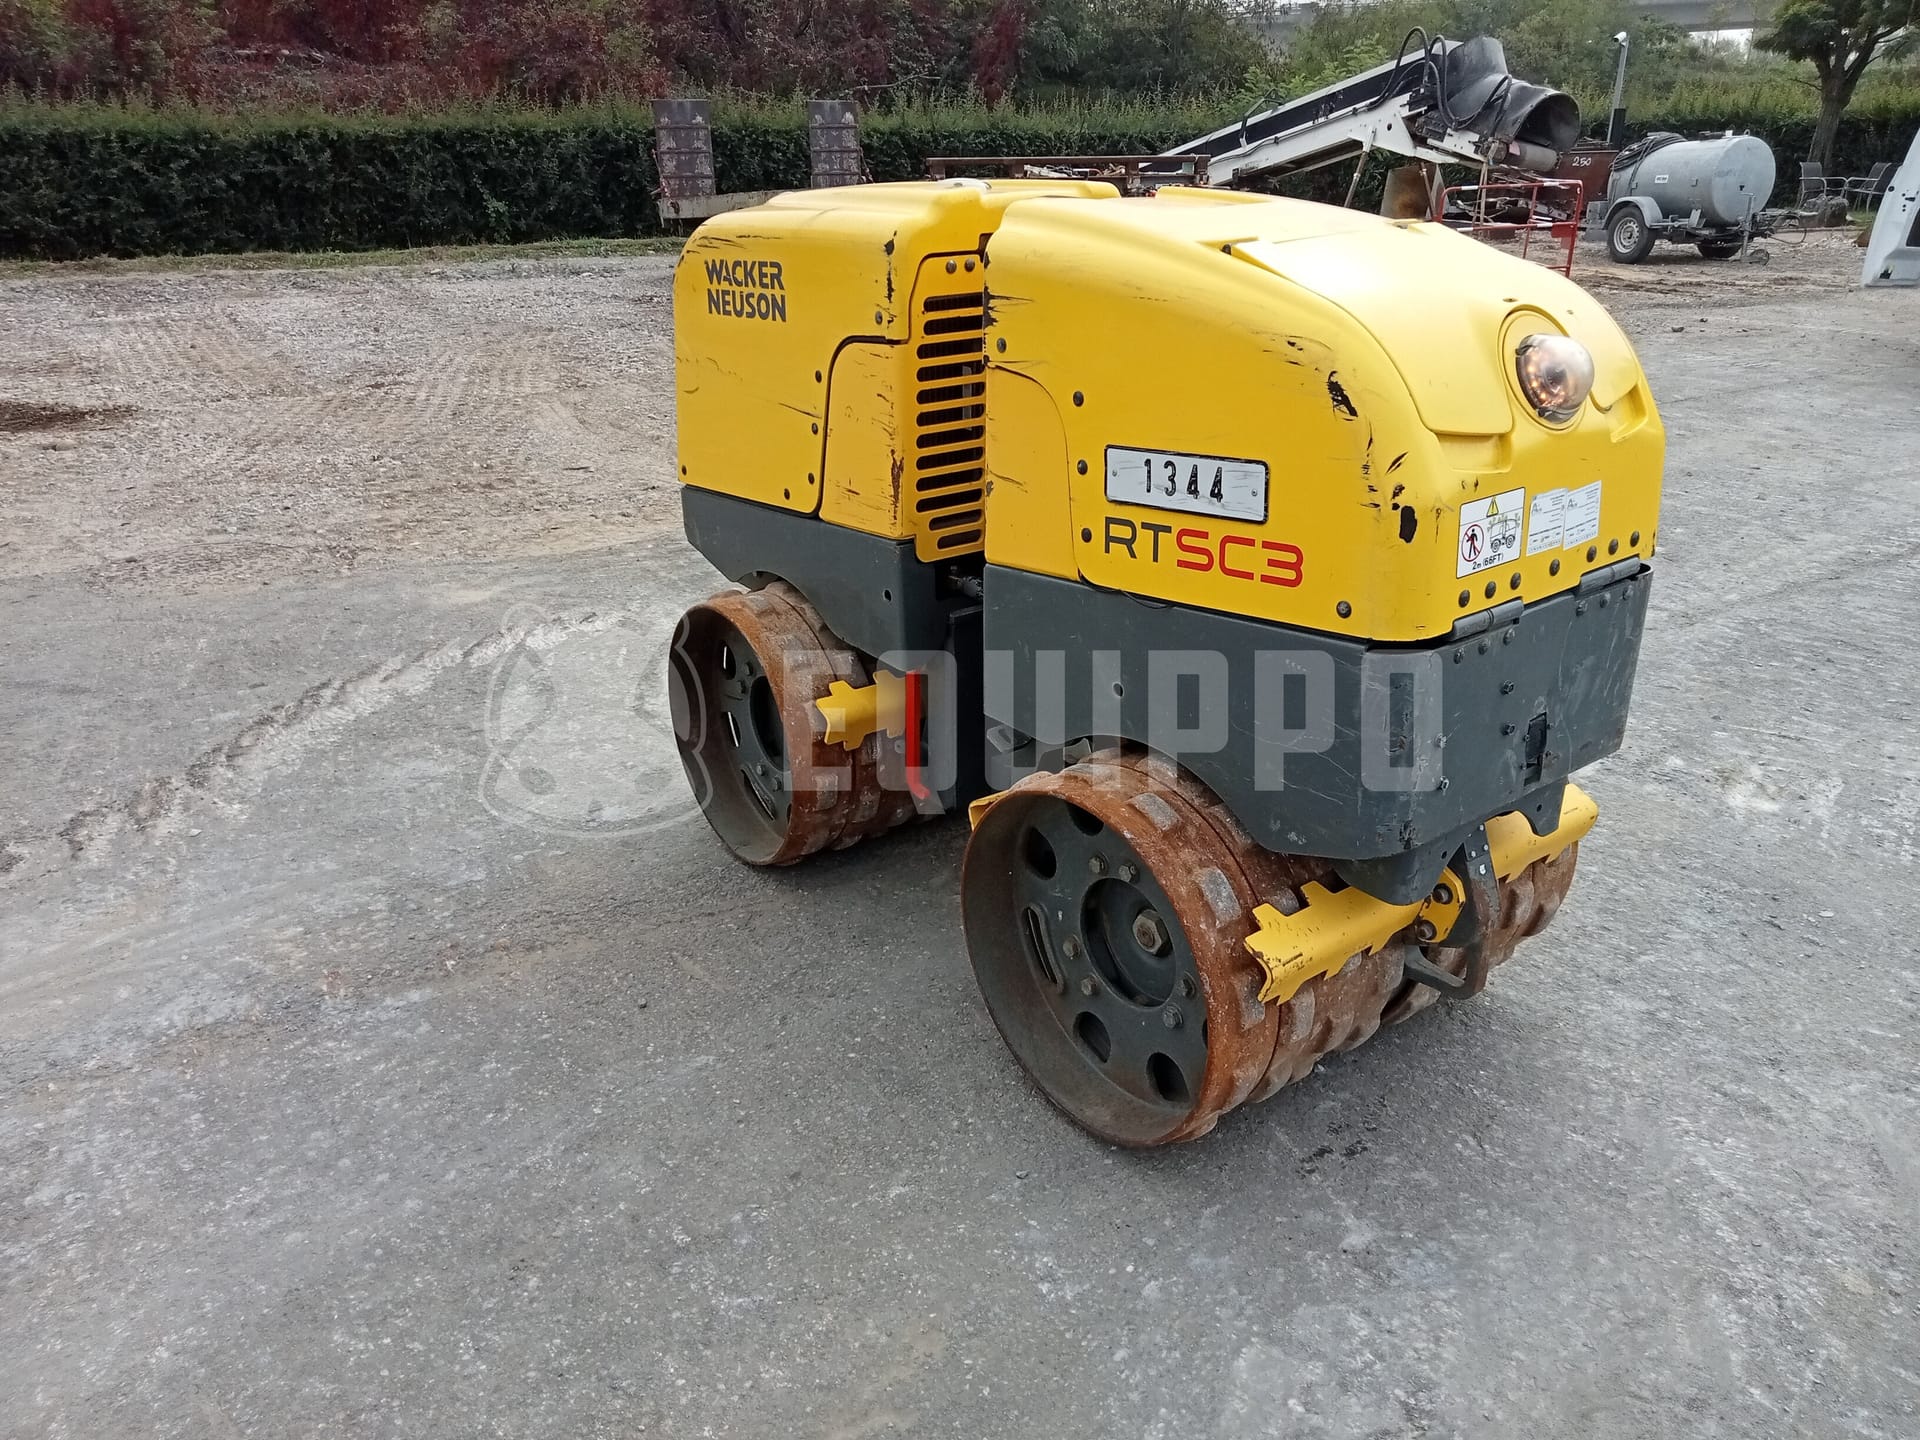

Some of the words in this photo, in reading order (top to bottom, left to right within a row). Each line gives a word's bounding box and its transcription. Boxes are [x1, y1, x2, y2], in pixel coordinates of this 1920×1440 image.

[1572, 156, 1592, 167] 250
[704, 258, 785, 291] WACKER
[707, 287, 787, 323] NEUSON
[1144, 458, 1223, 503] 1344
[1104, 516, 1304, 588] RTSC3
